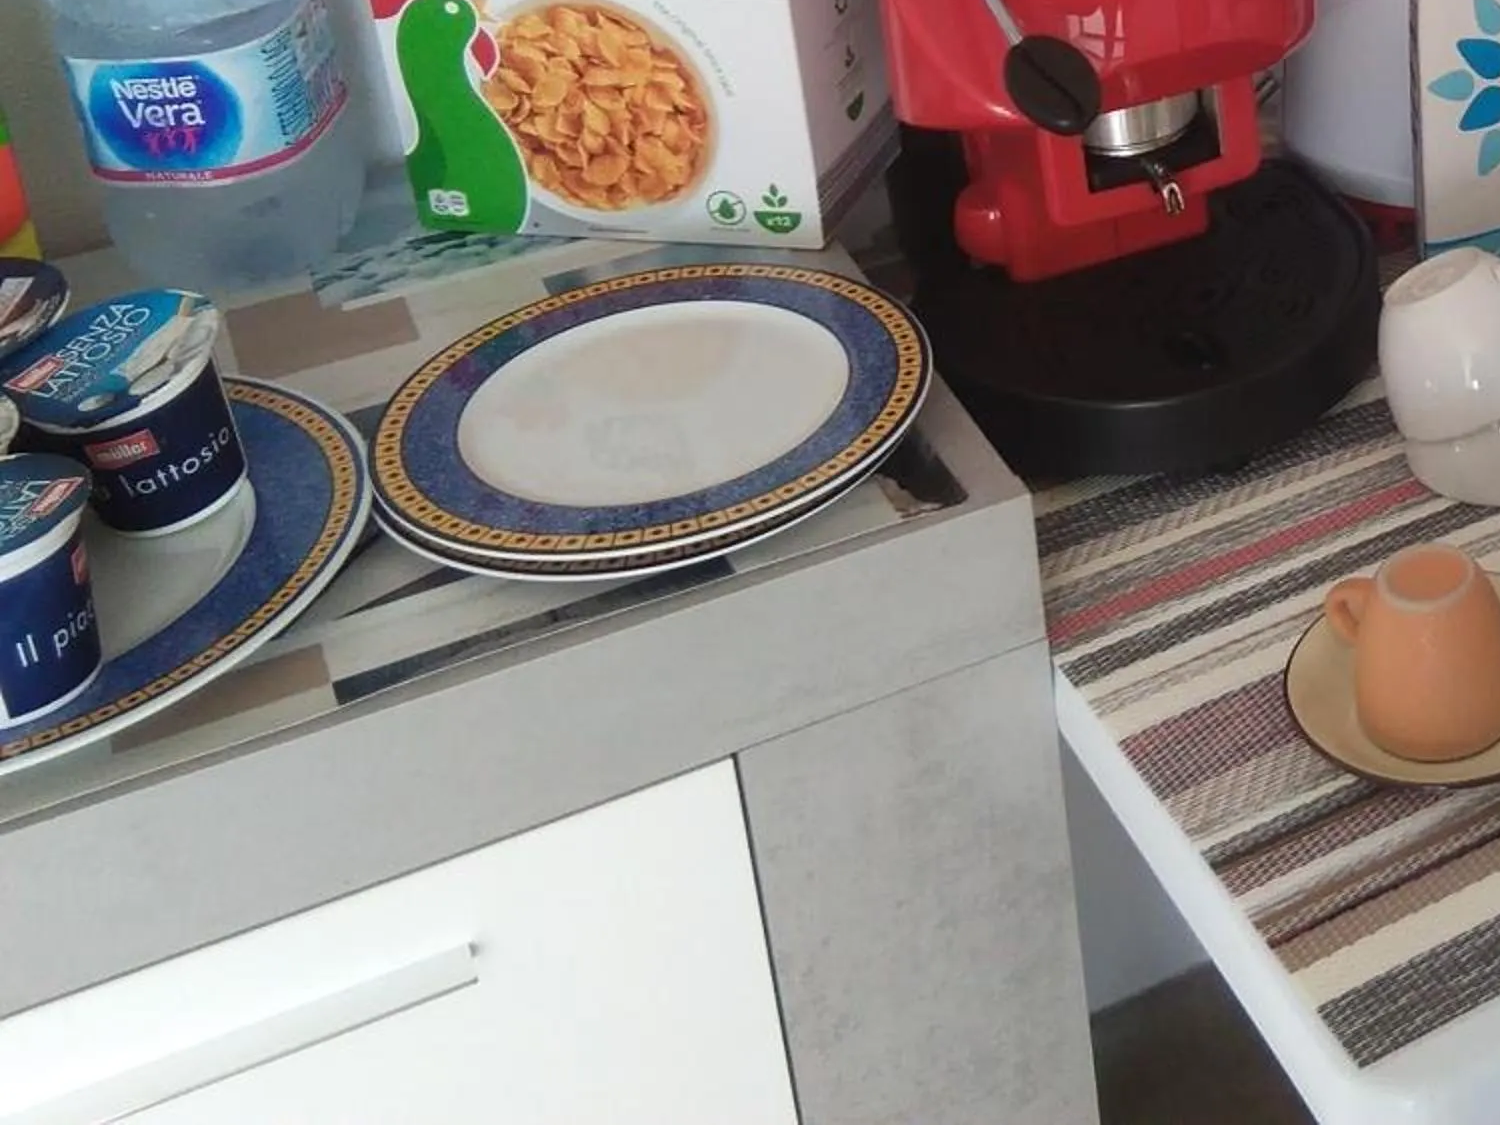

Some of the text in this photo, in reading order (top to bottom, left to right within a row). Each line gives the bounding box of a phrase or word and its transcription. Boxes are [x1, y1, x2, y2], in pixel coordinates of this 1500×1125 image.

[118, 100, 206, 129] Vera
[30, 307, 151, 399] LATTOSIO
[56, 303, 135, 362] SENZA
[118, 426, 230, 498] lattosio
